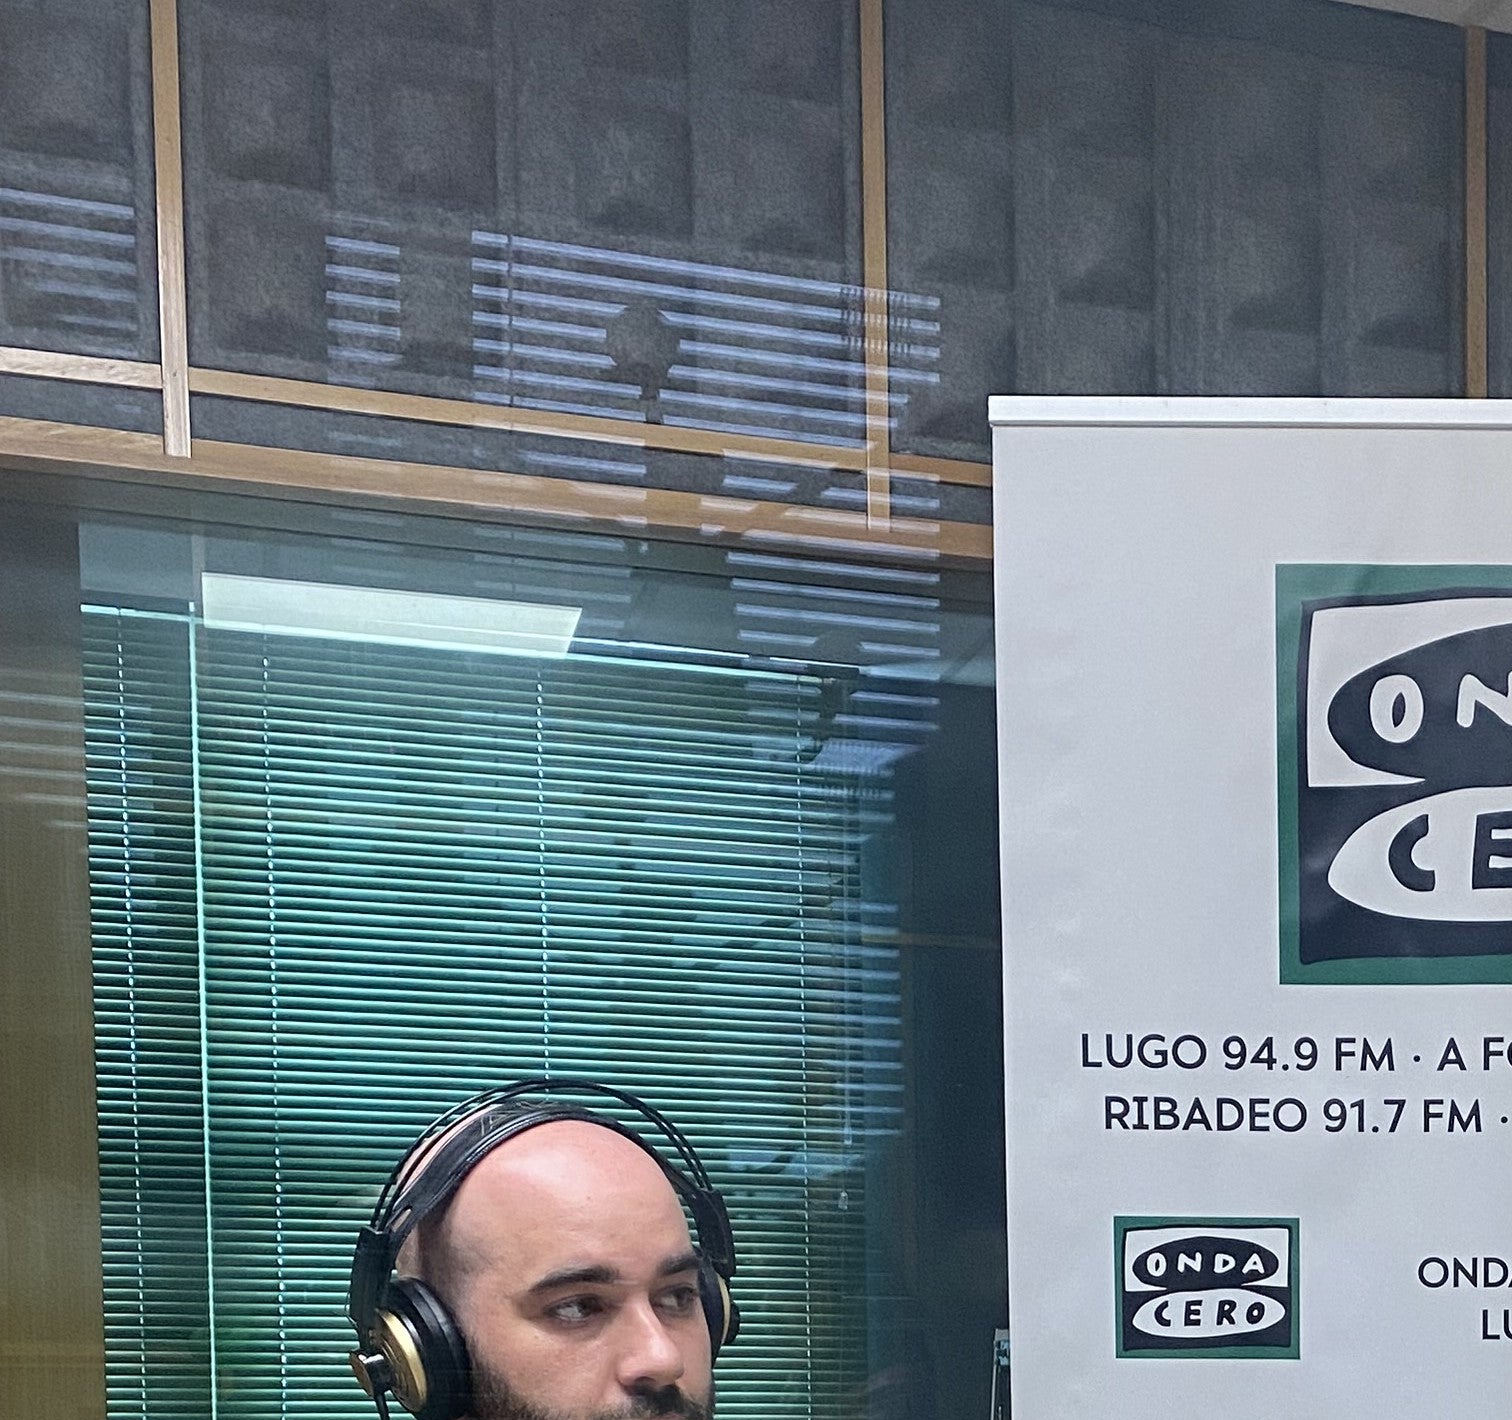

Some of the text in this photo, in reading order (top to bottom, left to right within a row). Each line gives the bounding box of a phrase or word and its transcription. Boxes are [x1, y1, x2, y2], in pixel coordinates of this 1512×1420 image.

[1081, 1033, 1207, 1070] LUGO
[1222, 1035, 1318, 1072] 94.9
[1335, 1037, 1395, 1072] FM
[1436, 1037, 1467, 1072] A
[1104, 1095, 1308, 1133] RIBADEO
[1323, 1098, 1407, 1134] 91.7
[1423, 1098, 1482, 1133] FM
[1148, 1252, 1268, 1274] ONDA
[1154, 1300, 1266, 1328] CERO
